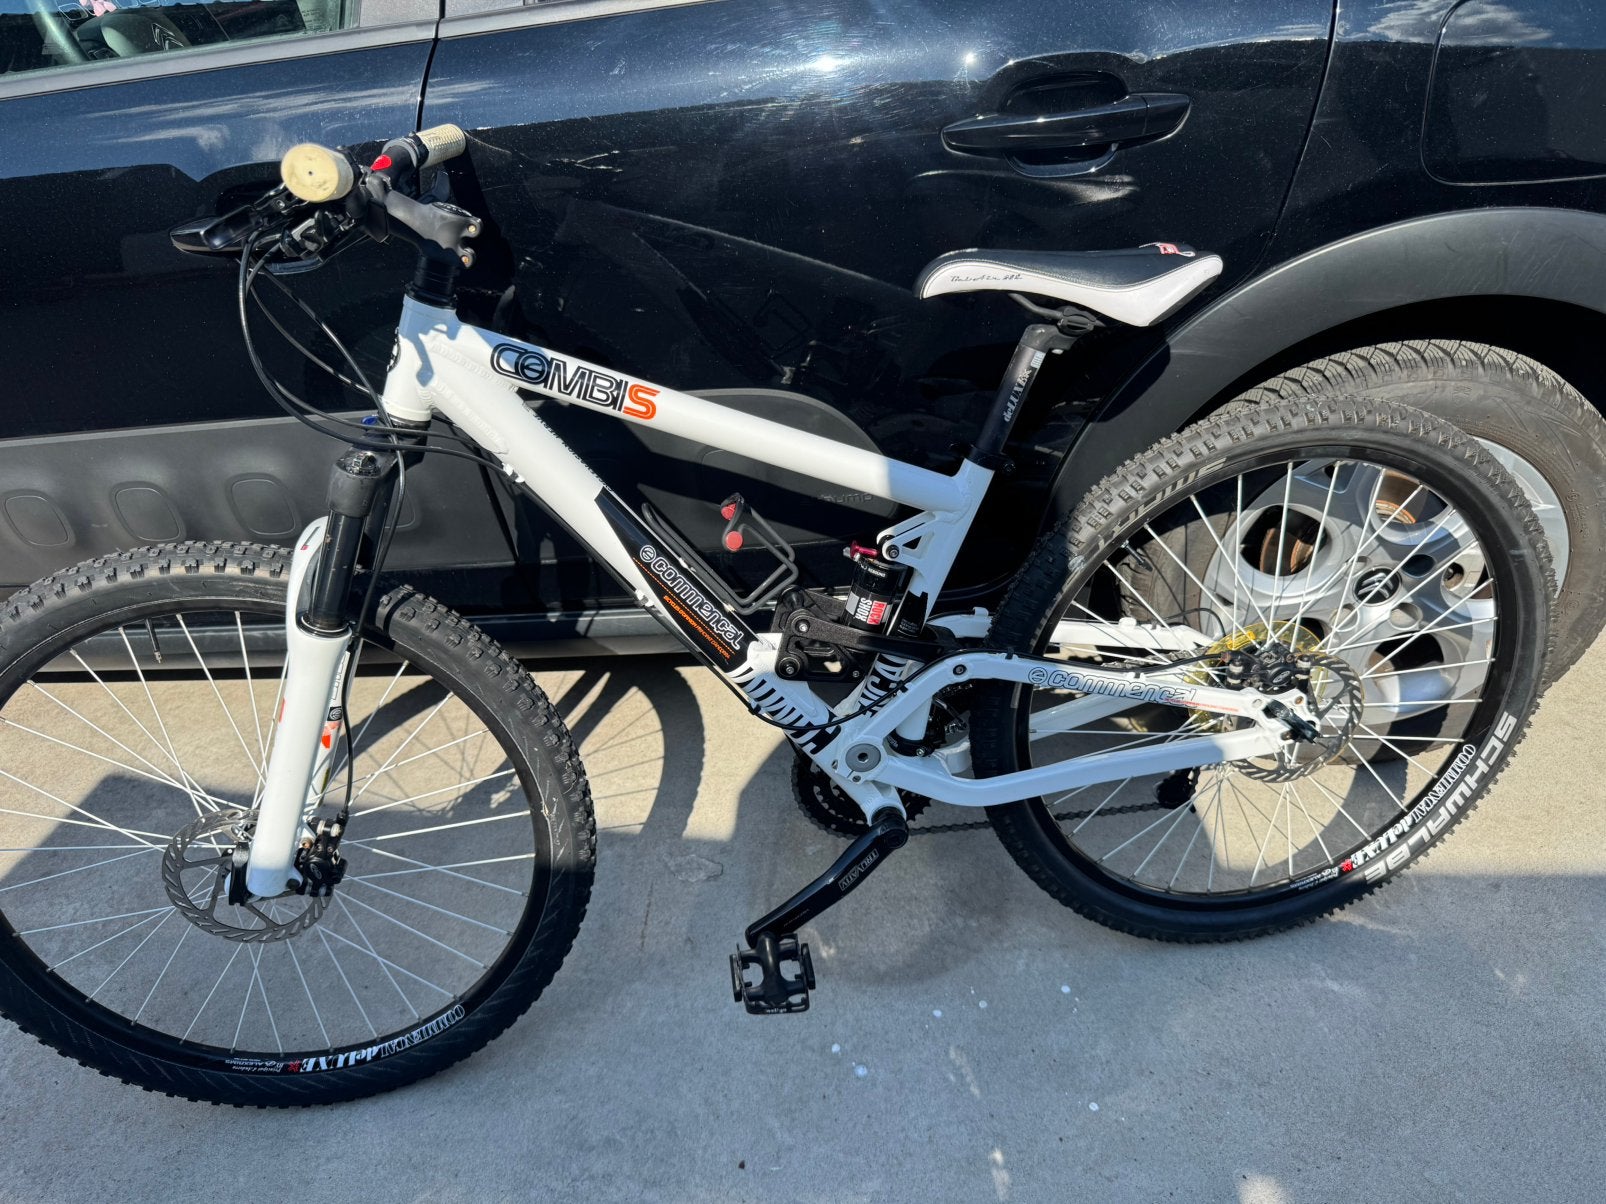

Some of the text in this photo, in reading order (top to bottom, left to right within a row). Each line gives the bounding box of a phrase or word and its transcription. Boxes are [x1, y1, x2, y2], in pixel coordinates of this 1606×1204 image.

[855, 598, 872, 622] SHOX
[1364, 711, 1518, 885] SCHWALBE
[1412, 744, 1476, 823] COMMENCAL
[299, 1004, 465, 1073] COMMENCAL deLUXE
